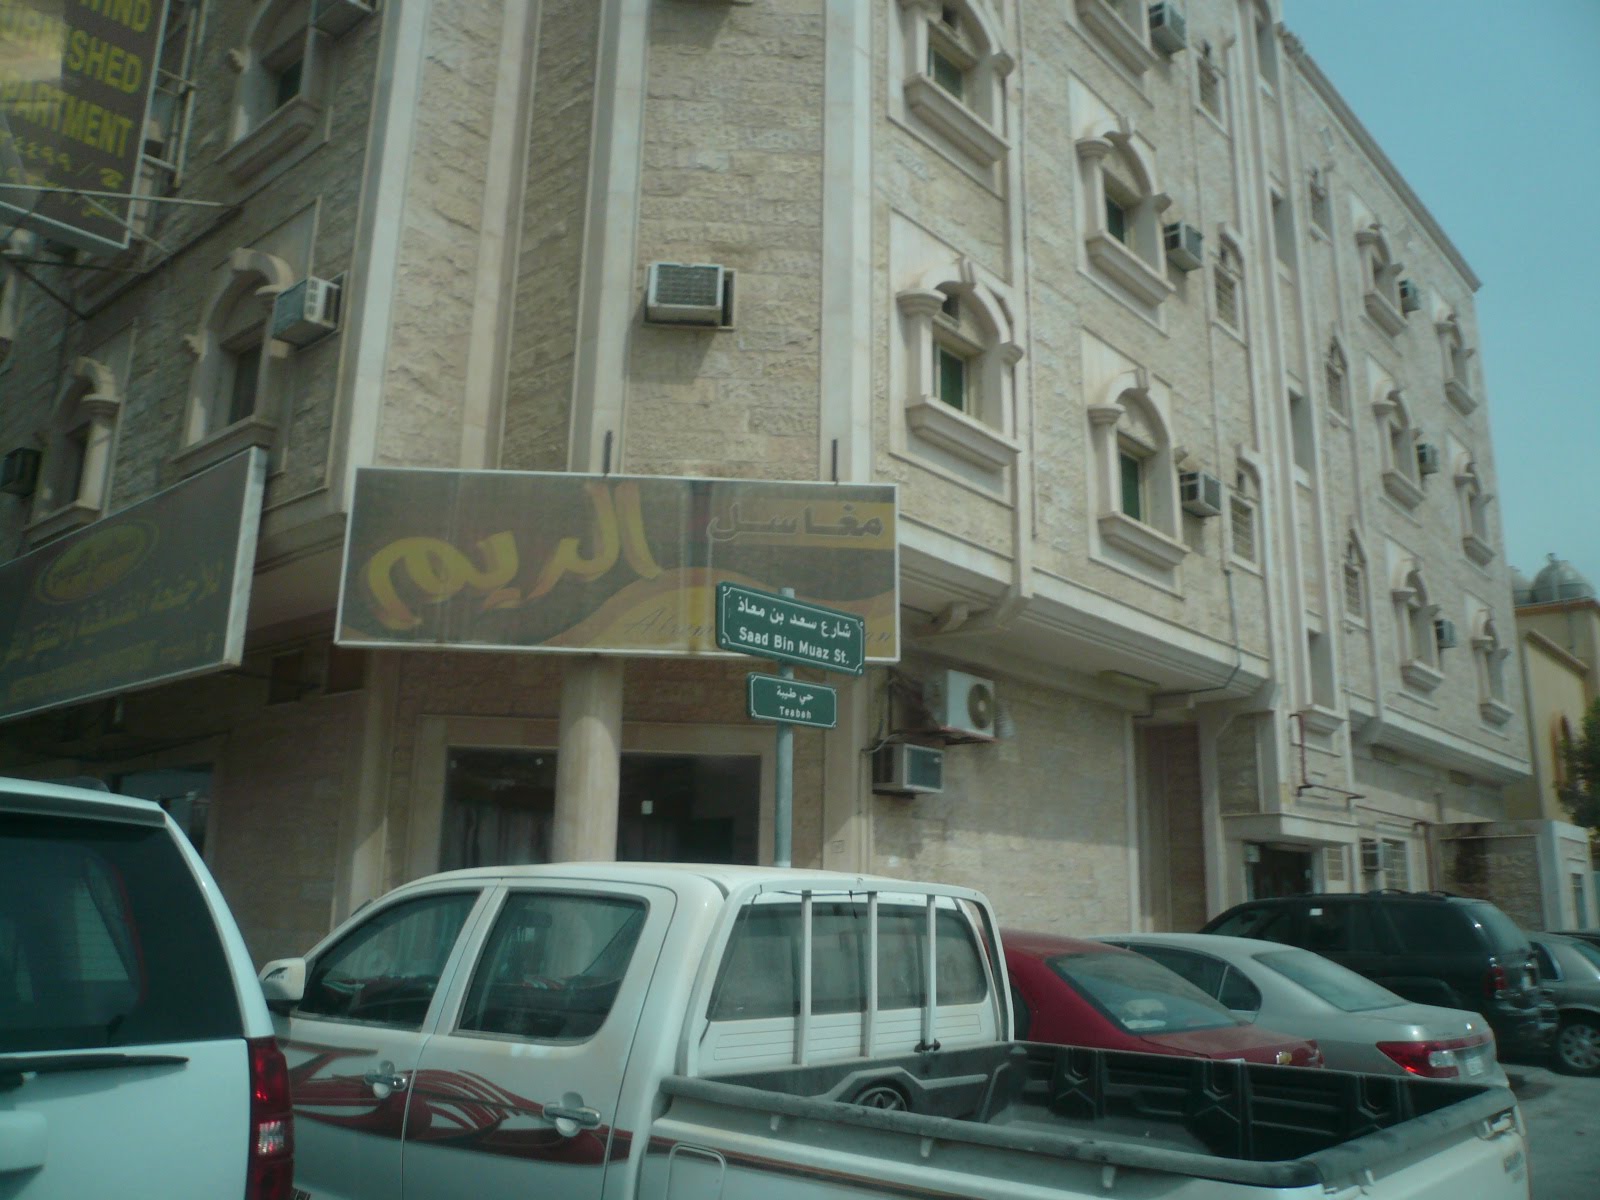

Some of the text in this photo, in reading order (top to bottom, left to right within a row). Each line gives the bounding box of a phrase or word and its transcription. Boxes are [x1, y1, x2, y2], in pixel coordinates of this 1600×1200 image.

[706, 502, 883, 542] مغاسل
[367, 481, 664, 630] الريم
[737, 595, 766, 617] معاذ
[769, 607, 785, 625] بن
[789, 612, 817, 629] سعد
[821, 620, 851, 638] شارع
[739, 626, 850, 665] Saad Bin Muaz St.
[776, 685, 814, 705] حي طيبة
[779, 705, 812, 719] Teabah
